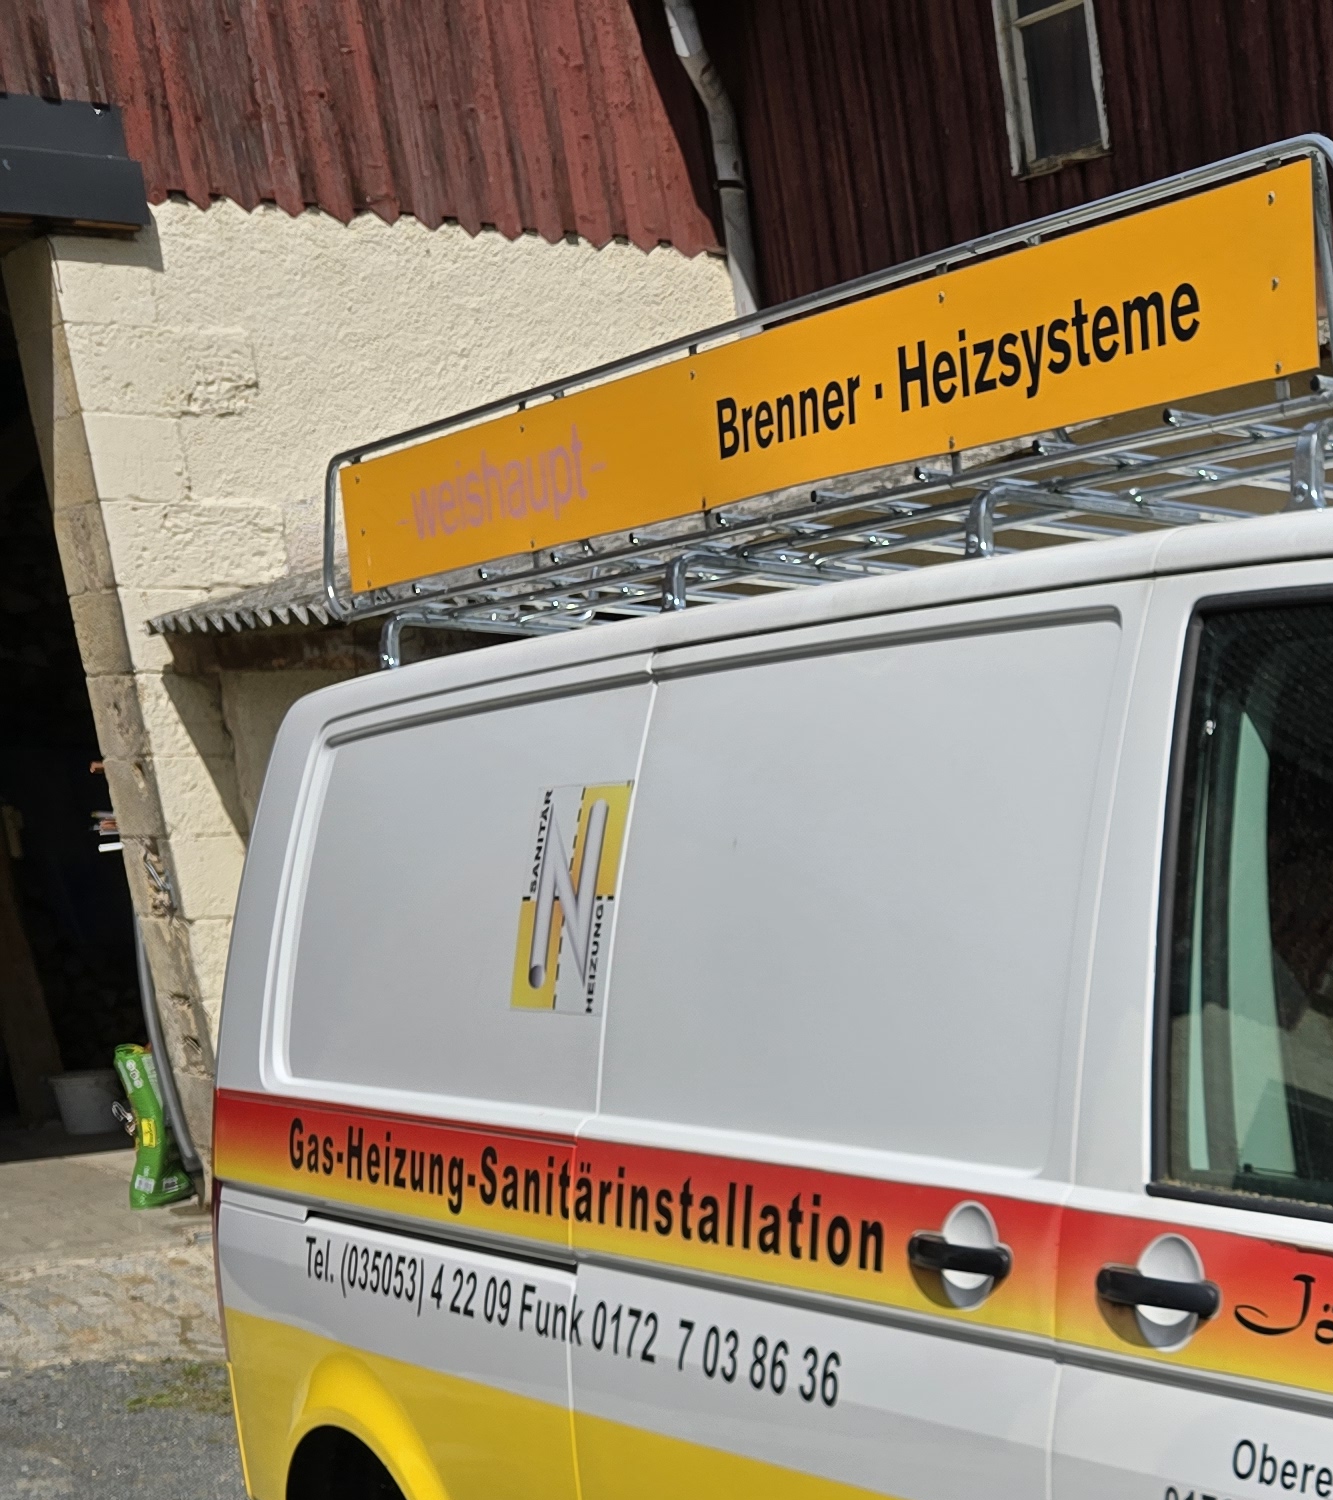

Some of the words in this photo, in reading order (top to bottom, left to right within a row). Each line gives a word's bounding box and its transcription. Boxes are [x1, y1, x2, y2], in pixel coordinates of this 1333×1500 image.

[715, 374, 861, 460] Brenner
[897, 280, 1202, 414] Heizsysteme
[585, 903, 605, 1014] HEIZUNG
[288, 1117, 885, 1273] Gas-Heizung-Sanitärinstallation
[305, 1236, 335, 1284] Tel.
[340, 1242, 425, 1318] (035053)
[430, 1263, 445, 1310] 4
[449, 1268, 478, 1318] 22
[483, 1276, 512, 1326] 09
[518, 1283, 584, 1346] Funk
[591, 1301, 659, 1365] 0172
[677, 1317, 696, 1371] 7
[702, 1325, 739, 1384] 03
[749, 1335, 790, 1395] 86
[799, 1345, 842, 1407] 36
